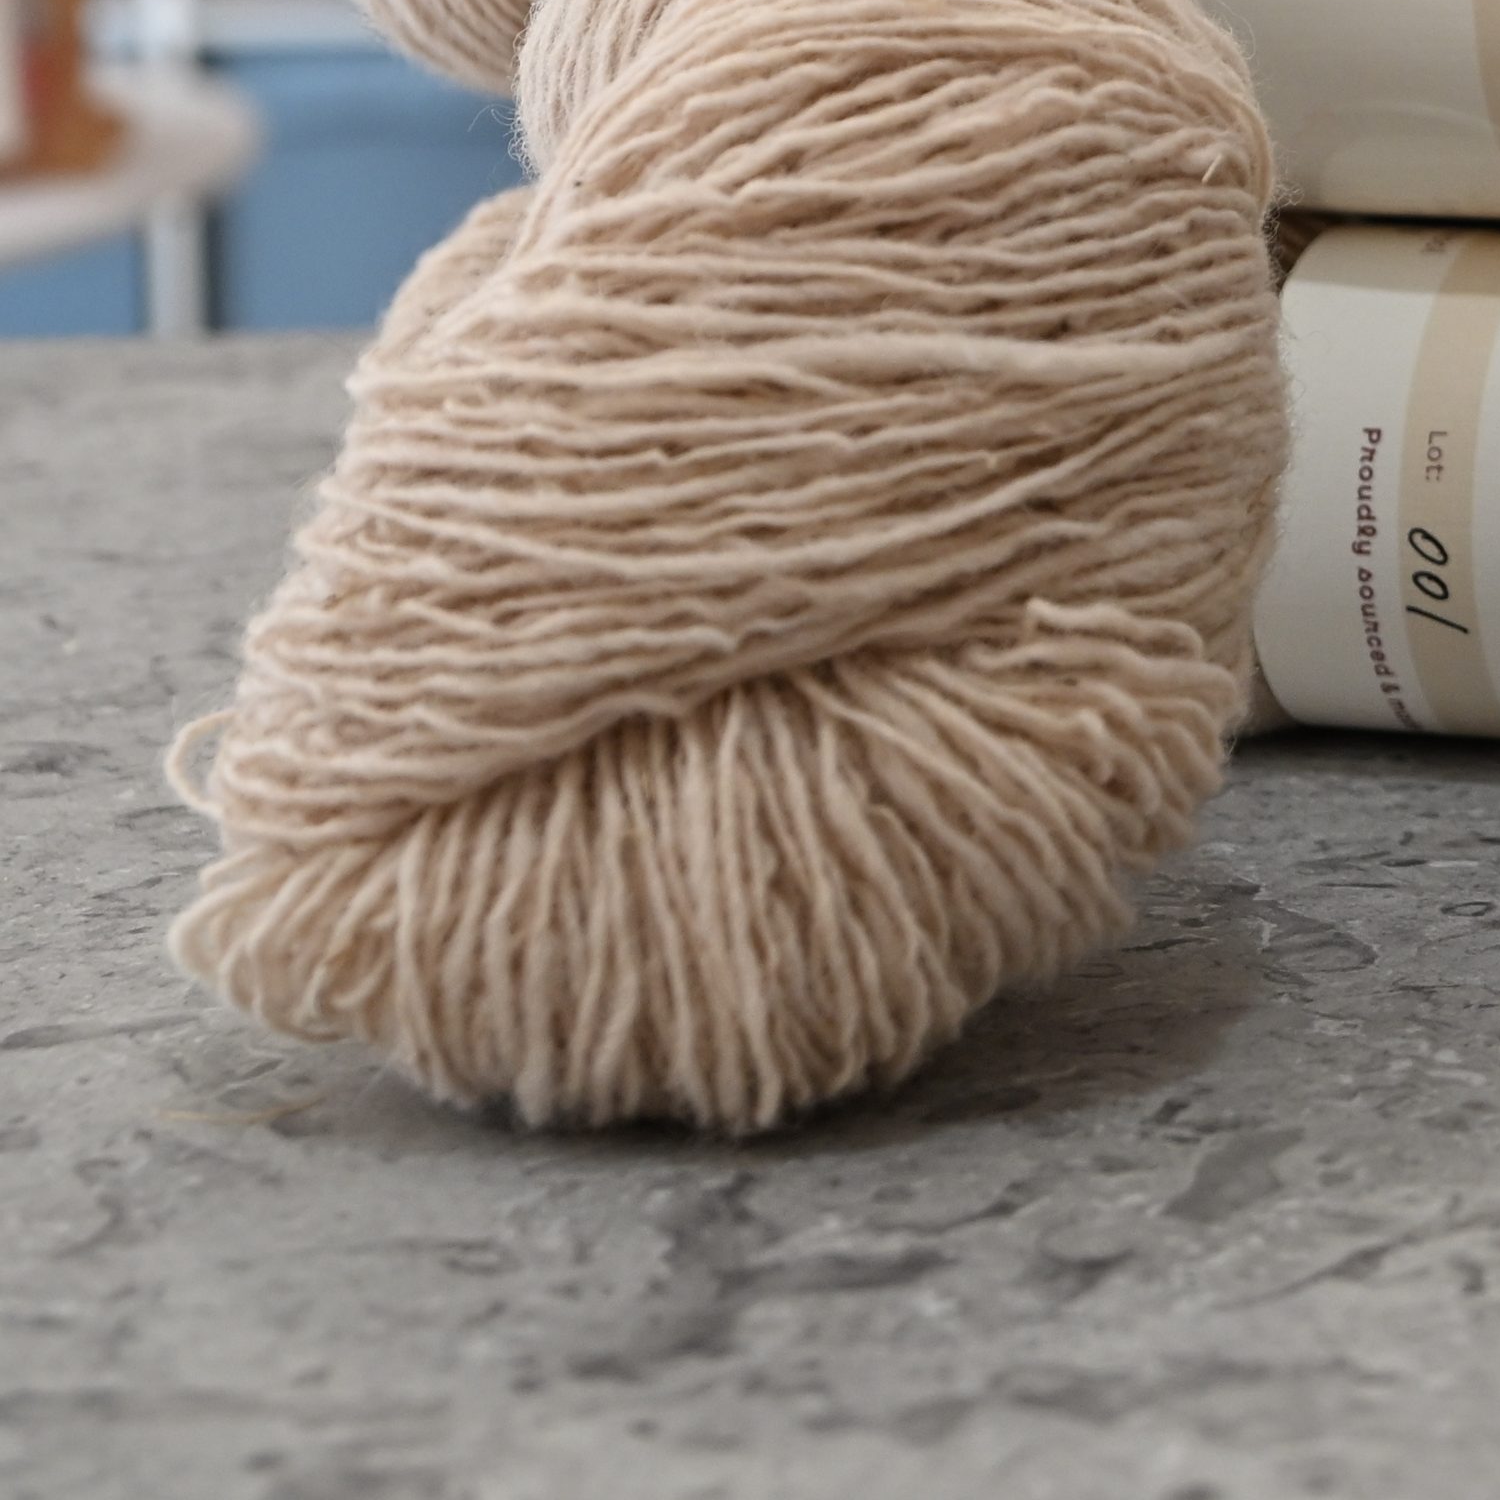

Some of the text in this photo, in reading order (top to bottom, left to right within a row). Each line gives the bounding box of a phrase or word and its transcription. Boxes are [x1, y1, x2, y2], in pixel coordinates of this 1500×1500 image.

[1351, 426, 1383, 557] Proudly
[1426, 430, 1448, 482] Lot:
[1356, 567, 1395, 677] sourced
[1404, 526, 1469, 635] 001
